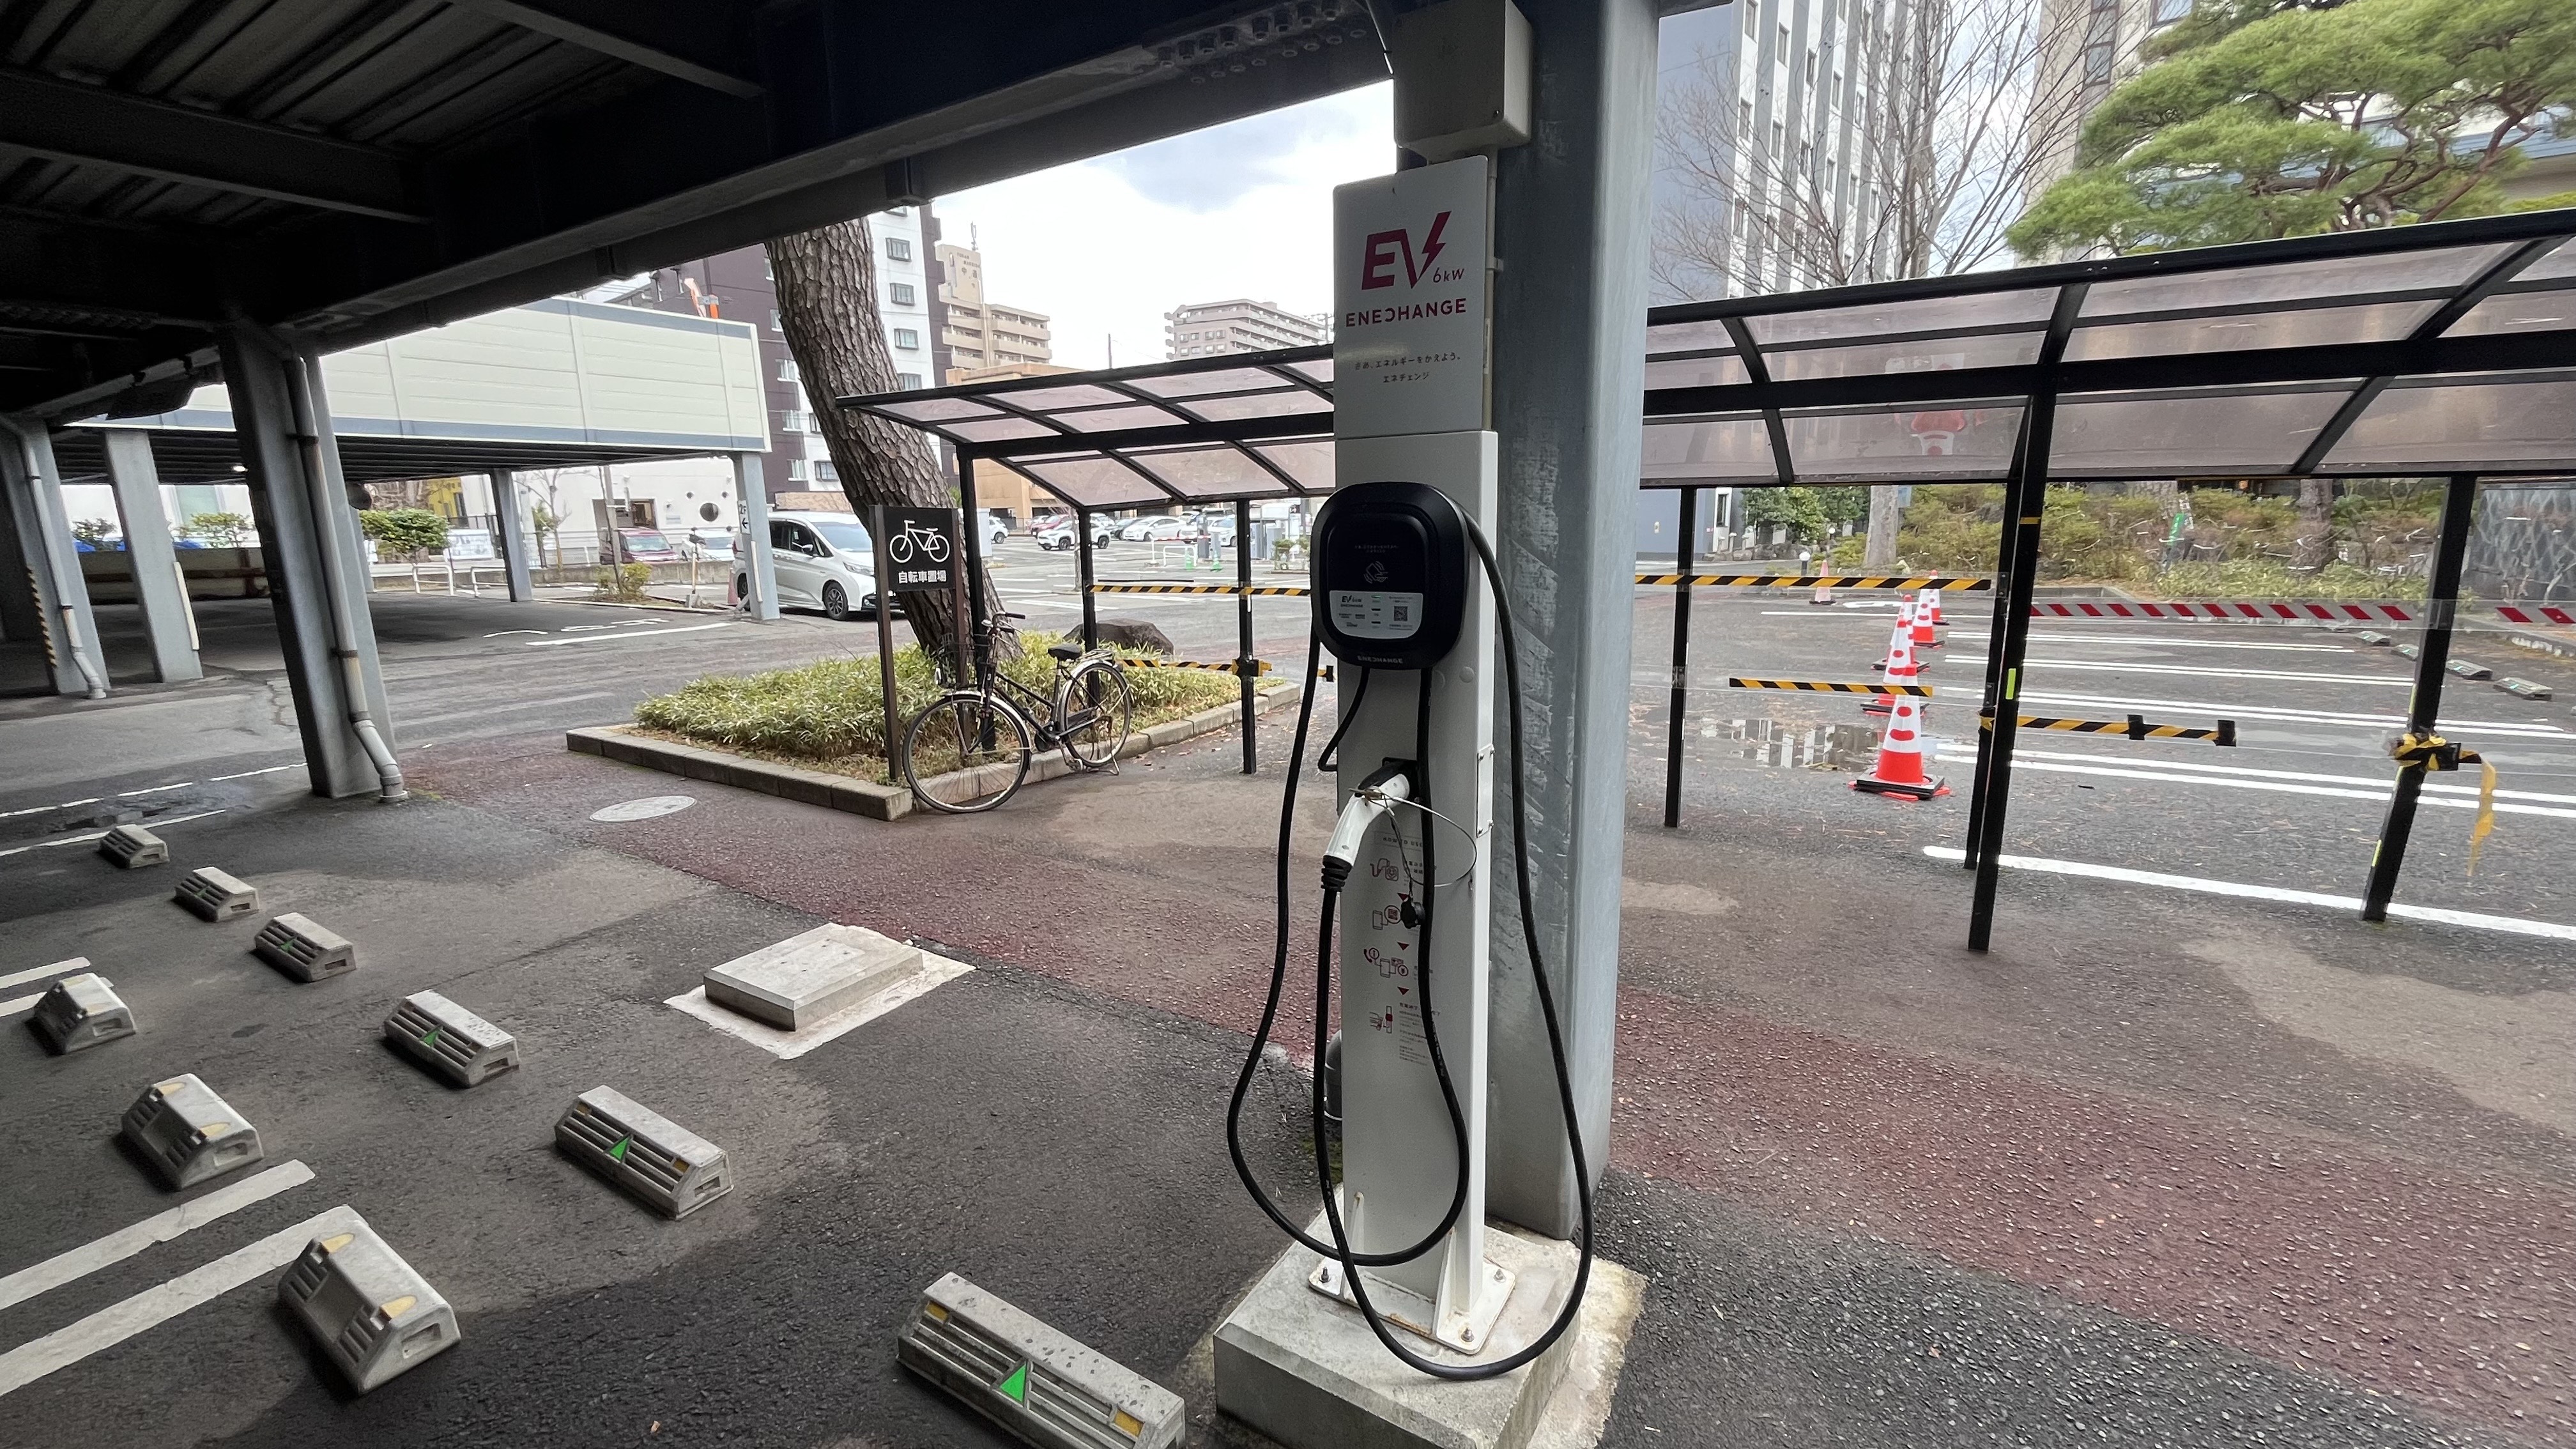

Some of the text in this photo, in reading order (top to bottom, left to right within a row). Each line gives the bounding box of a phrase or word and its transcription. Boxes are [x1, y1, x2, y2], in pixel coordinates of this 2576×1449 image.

[1361, 210, 1465, 290] EV 6kW
[1346, 298, 1467, 328] ENECHANGE
[1383, 371, 1430, 383] エネチェンジ
[898, 570, 947, 584] 自転車置場
